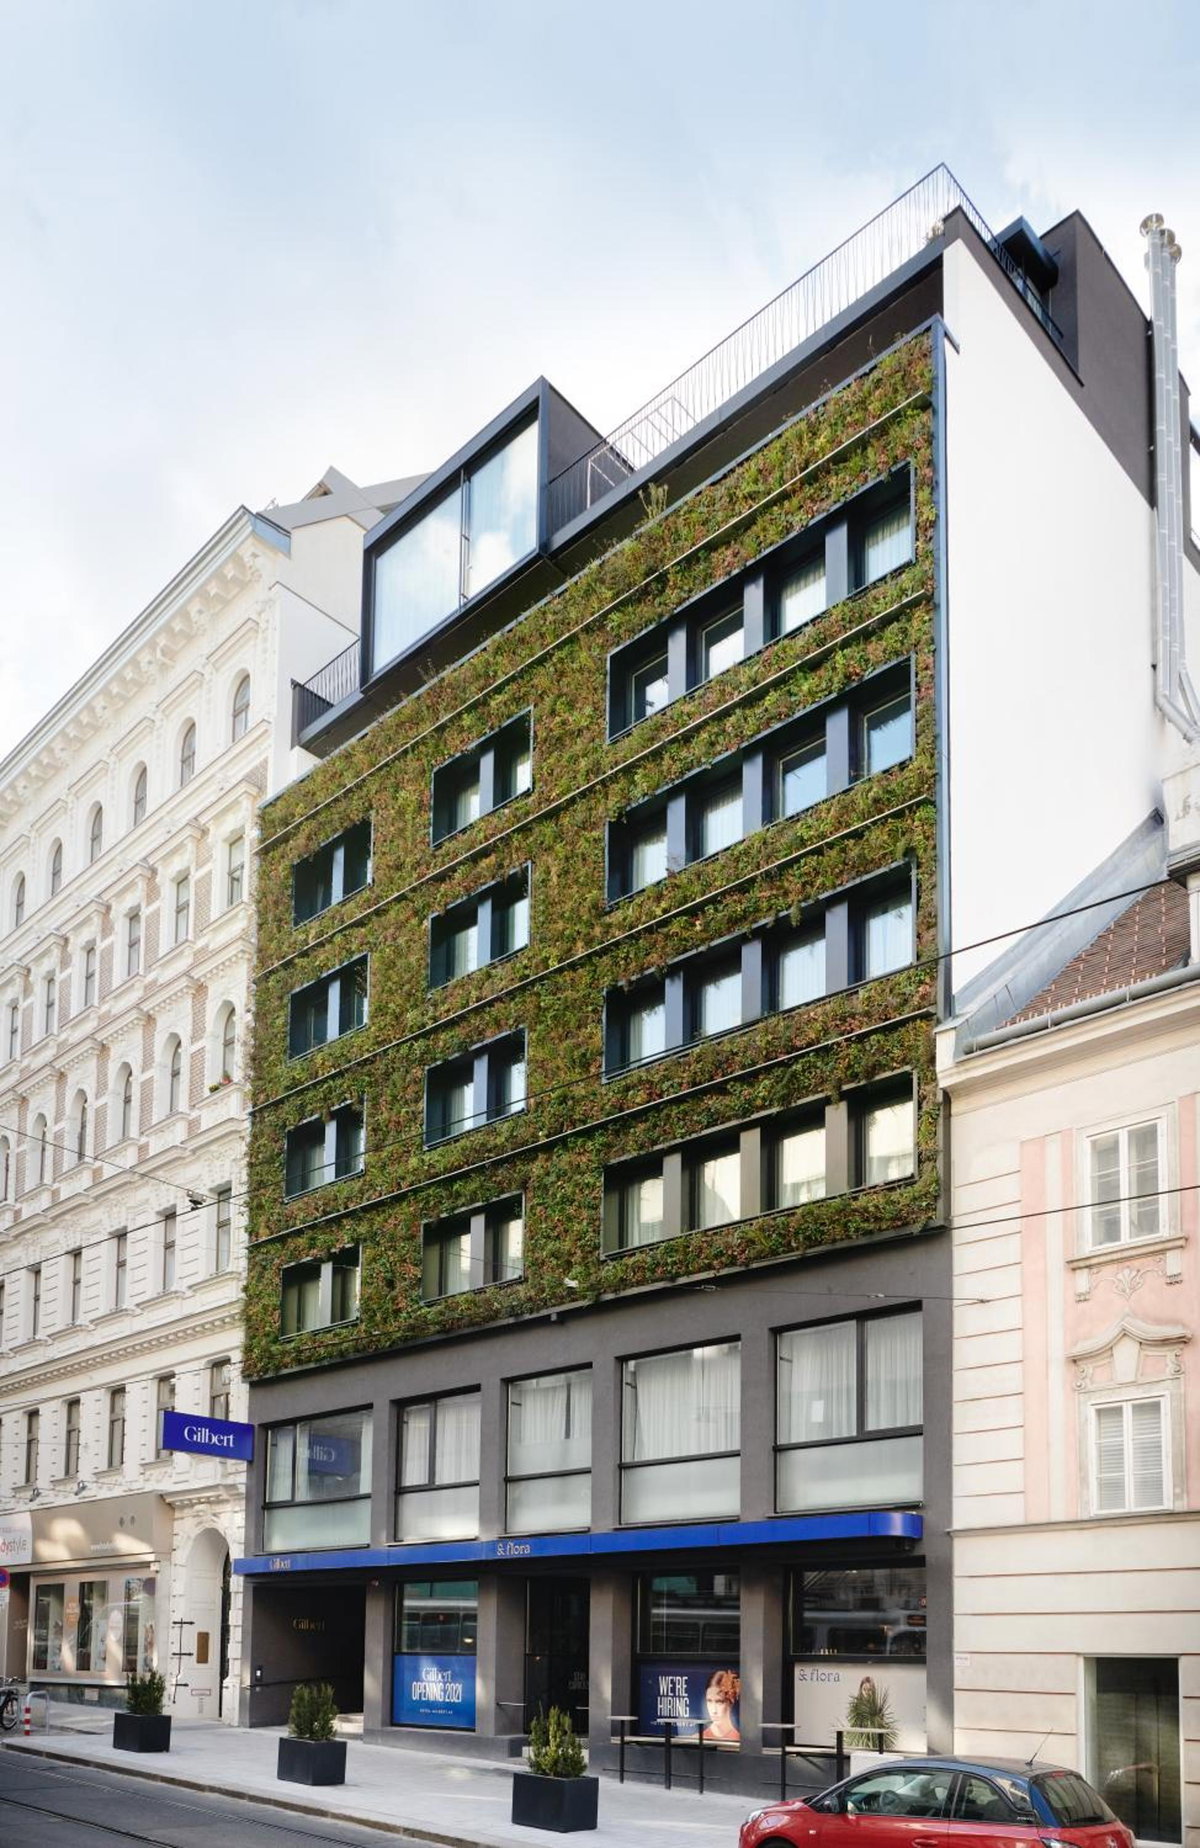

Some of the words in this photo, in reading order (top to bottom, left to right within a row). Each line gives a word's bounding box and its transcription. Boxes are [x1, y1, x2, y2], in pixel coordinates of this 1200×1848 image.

[184, 1425, 235, 1448] Gilbert
[497, 1543, 505, 1556] &
[507, 1541, 530, 1555] flora
[422, 1667, 452, 1682] Gilbert
[799, 1669, 808, 1682] &
[810, 1669, 840, 1682] flora
[412, 1682, 443, 1701] OPENING
[658, 1675, 688, 1697] WE'RE
[657, 1696, 690, 1718] HIRING
